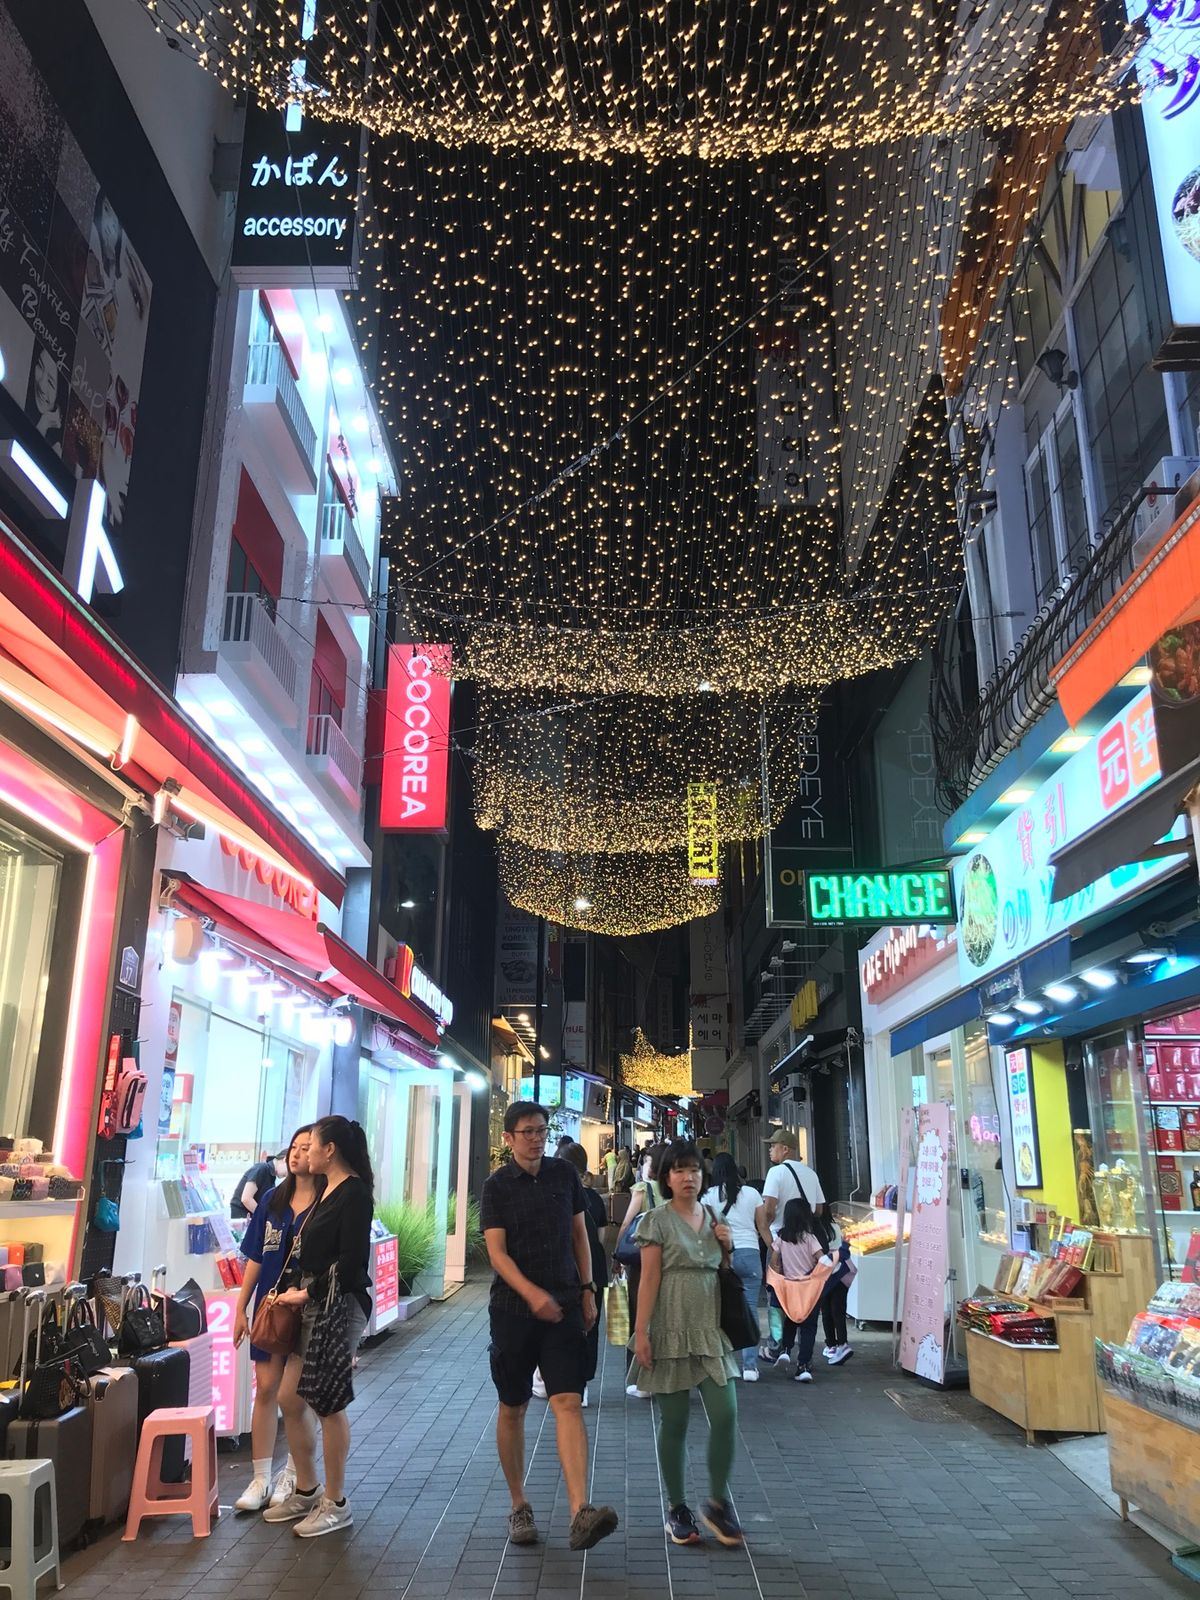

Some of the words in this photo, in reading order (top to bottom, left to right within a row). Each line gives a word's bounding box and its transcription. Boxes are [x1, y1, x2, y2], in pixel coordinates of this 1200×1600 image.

[251, 153, 348, 187] かばん
[243, 216, 347, 240] accessory
[22, 282, 71, 373] Beauty
[400, 655, 433, 820] COCOREA
[797, 713, 826, 840] REDEYE
[1101, 738, 1127, 791] 元
[809, 873, 949, 919] CHANGE
[862, 949, 882, 992] CAFE
[697, 1013, 723, 1025] 세마
[207, 1301, 231, 1333] 2
